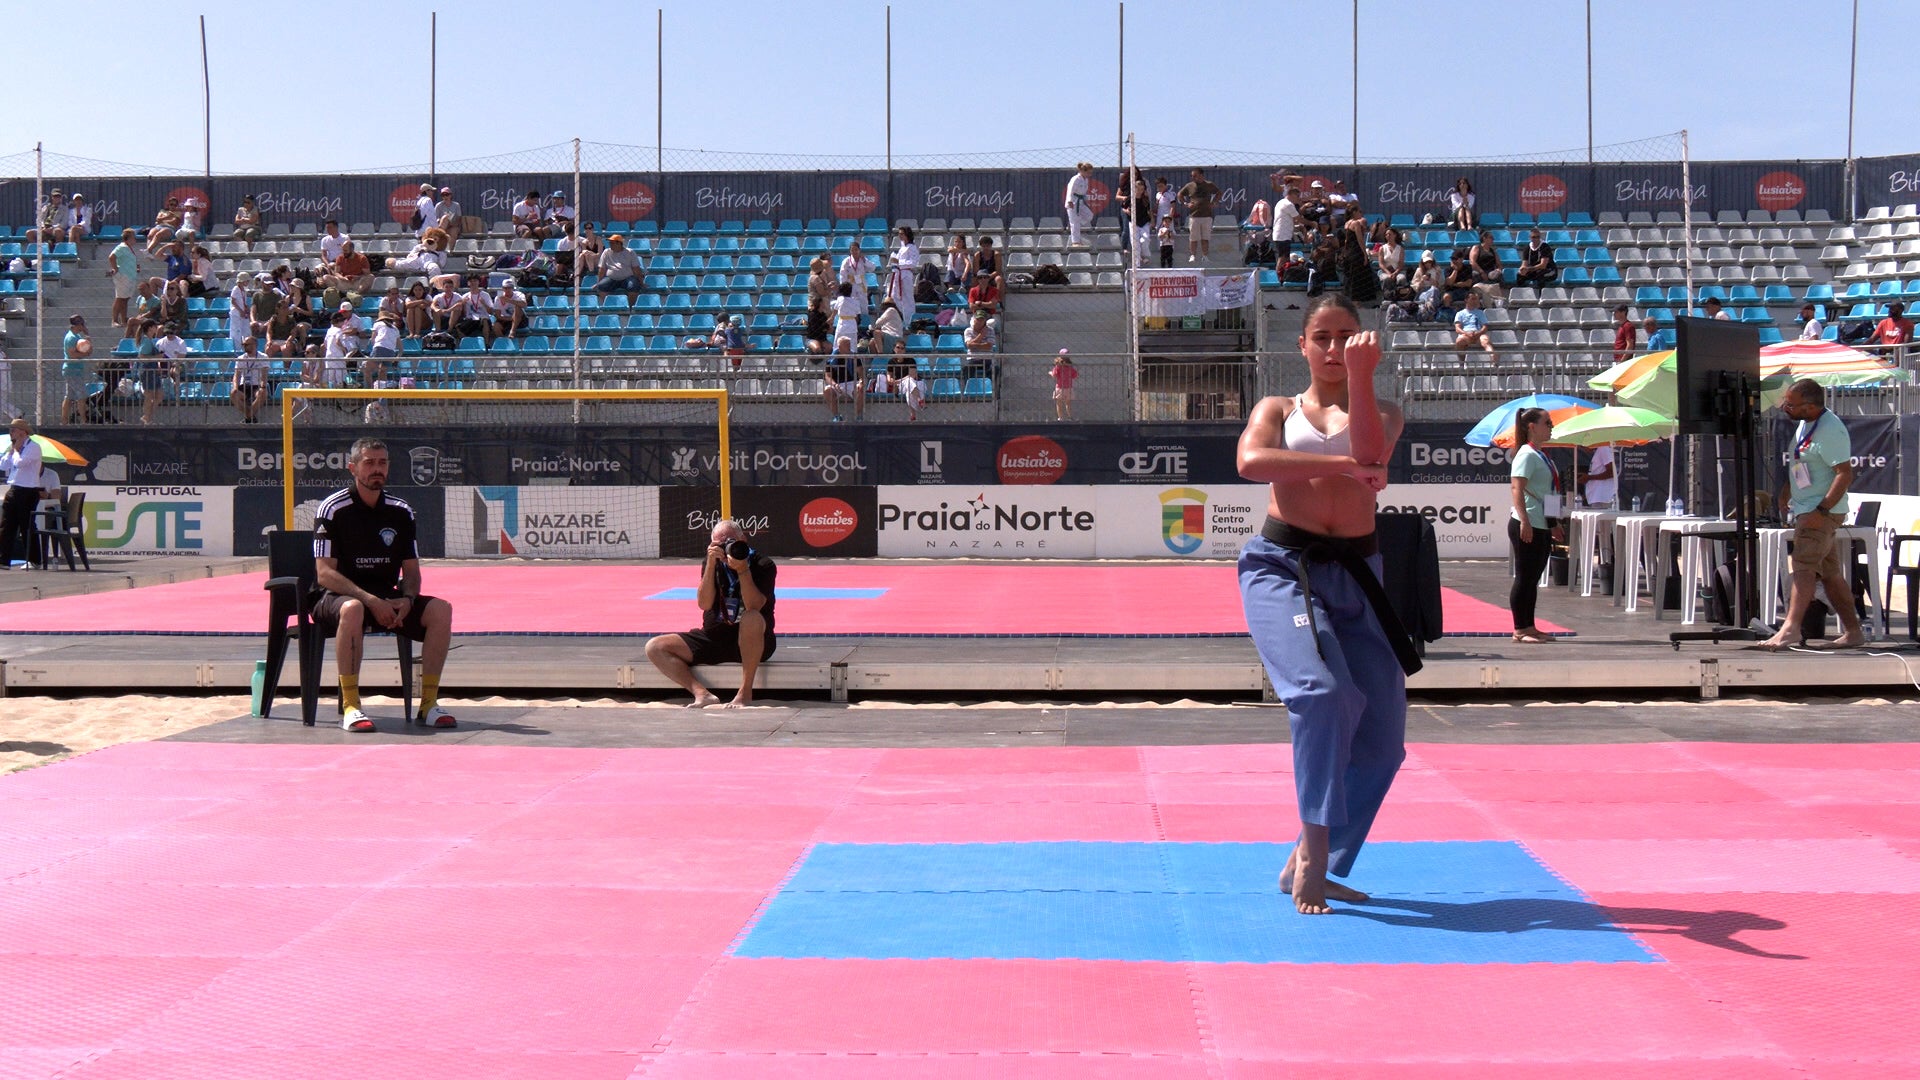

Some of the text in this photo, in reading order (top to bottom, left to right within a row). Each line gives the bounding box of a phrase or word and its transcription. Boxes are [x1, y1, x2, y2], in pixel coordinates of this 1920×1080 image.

[255, 191, 343, 219] Bifranga
[695, 187, 783, 215] Bifranga
[925, 185, 1014, 214] Bifranga
[1150, 275, 1197, 286] TAEKWONDO
[1152, 286, 1196, 297] ALHANDRA
[133, 460, 189, 475] NAZARÉ
[511, 456, 558, 472] Praia
[569, 457, 622, 472] Norte
[754, 449, 867, 484] Portugal
[237, 477, 278, 488] Cidade
[1411, 472, 1512, 483] Cidade do Autom
[115, 486, 202, 496] PORTUGAL
[1212, 504, 1251, 513] Turismo
[525, 510, 606, 529] NAZARÉ
[878, 501, 1095, 531] Praia do Norte
[1211, 514, 1245, 524] Centro
[1211, 524, 1254, 536] Portugal
[524, 530, 631, 548] QUALIFICA
[1435, 532, 1492, 543] utomóvel
[926, 540, 1046, 548] NAZARÉ
